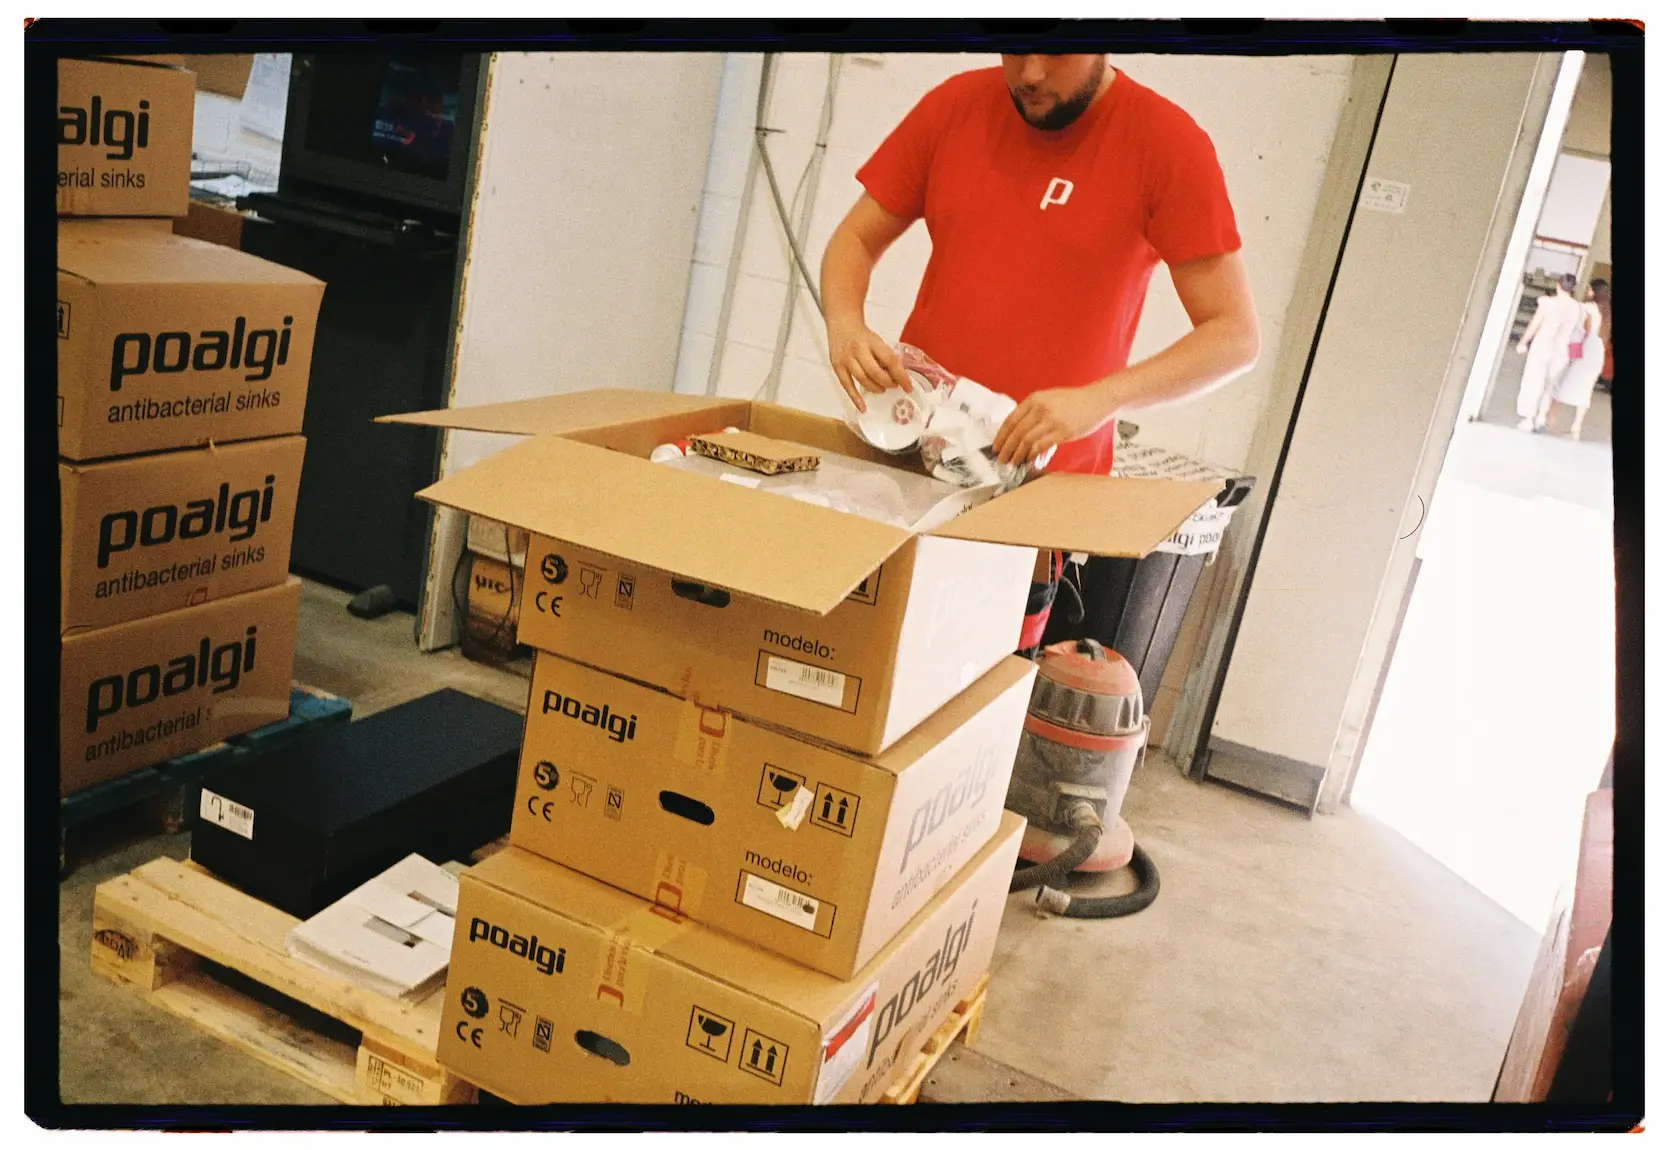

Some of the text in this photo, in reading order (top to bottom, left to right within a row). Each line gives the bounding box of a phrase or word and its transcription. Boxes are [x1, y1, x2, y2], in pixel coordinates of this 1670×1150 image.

[100, 168, 146, 188] sinks
[110, 315, 294, 391] poalgi
[107, 388, 281, 424] antibacterial sinks
[96, 474, 276, 569] poalgi
[94, 545, 265, 599] antibacterial sinks
[535, 591, 563, 617] CE
[763, 628, 835, 660] modelo:
[86, 625, 258, 734] poalgi
[85, 707, 201, 762] antibacterial
[542, 689, 638, 743] poalgi
[528, 796, 555, 822] CE
[745, 850, 813, 886] modelo:
[469, 917, 566, 976] poalgi
[866, 897, 979, 1071] poalgi
[456, 1020, 484, 1049] CE
